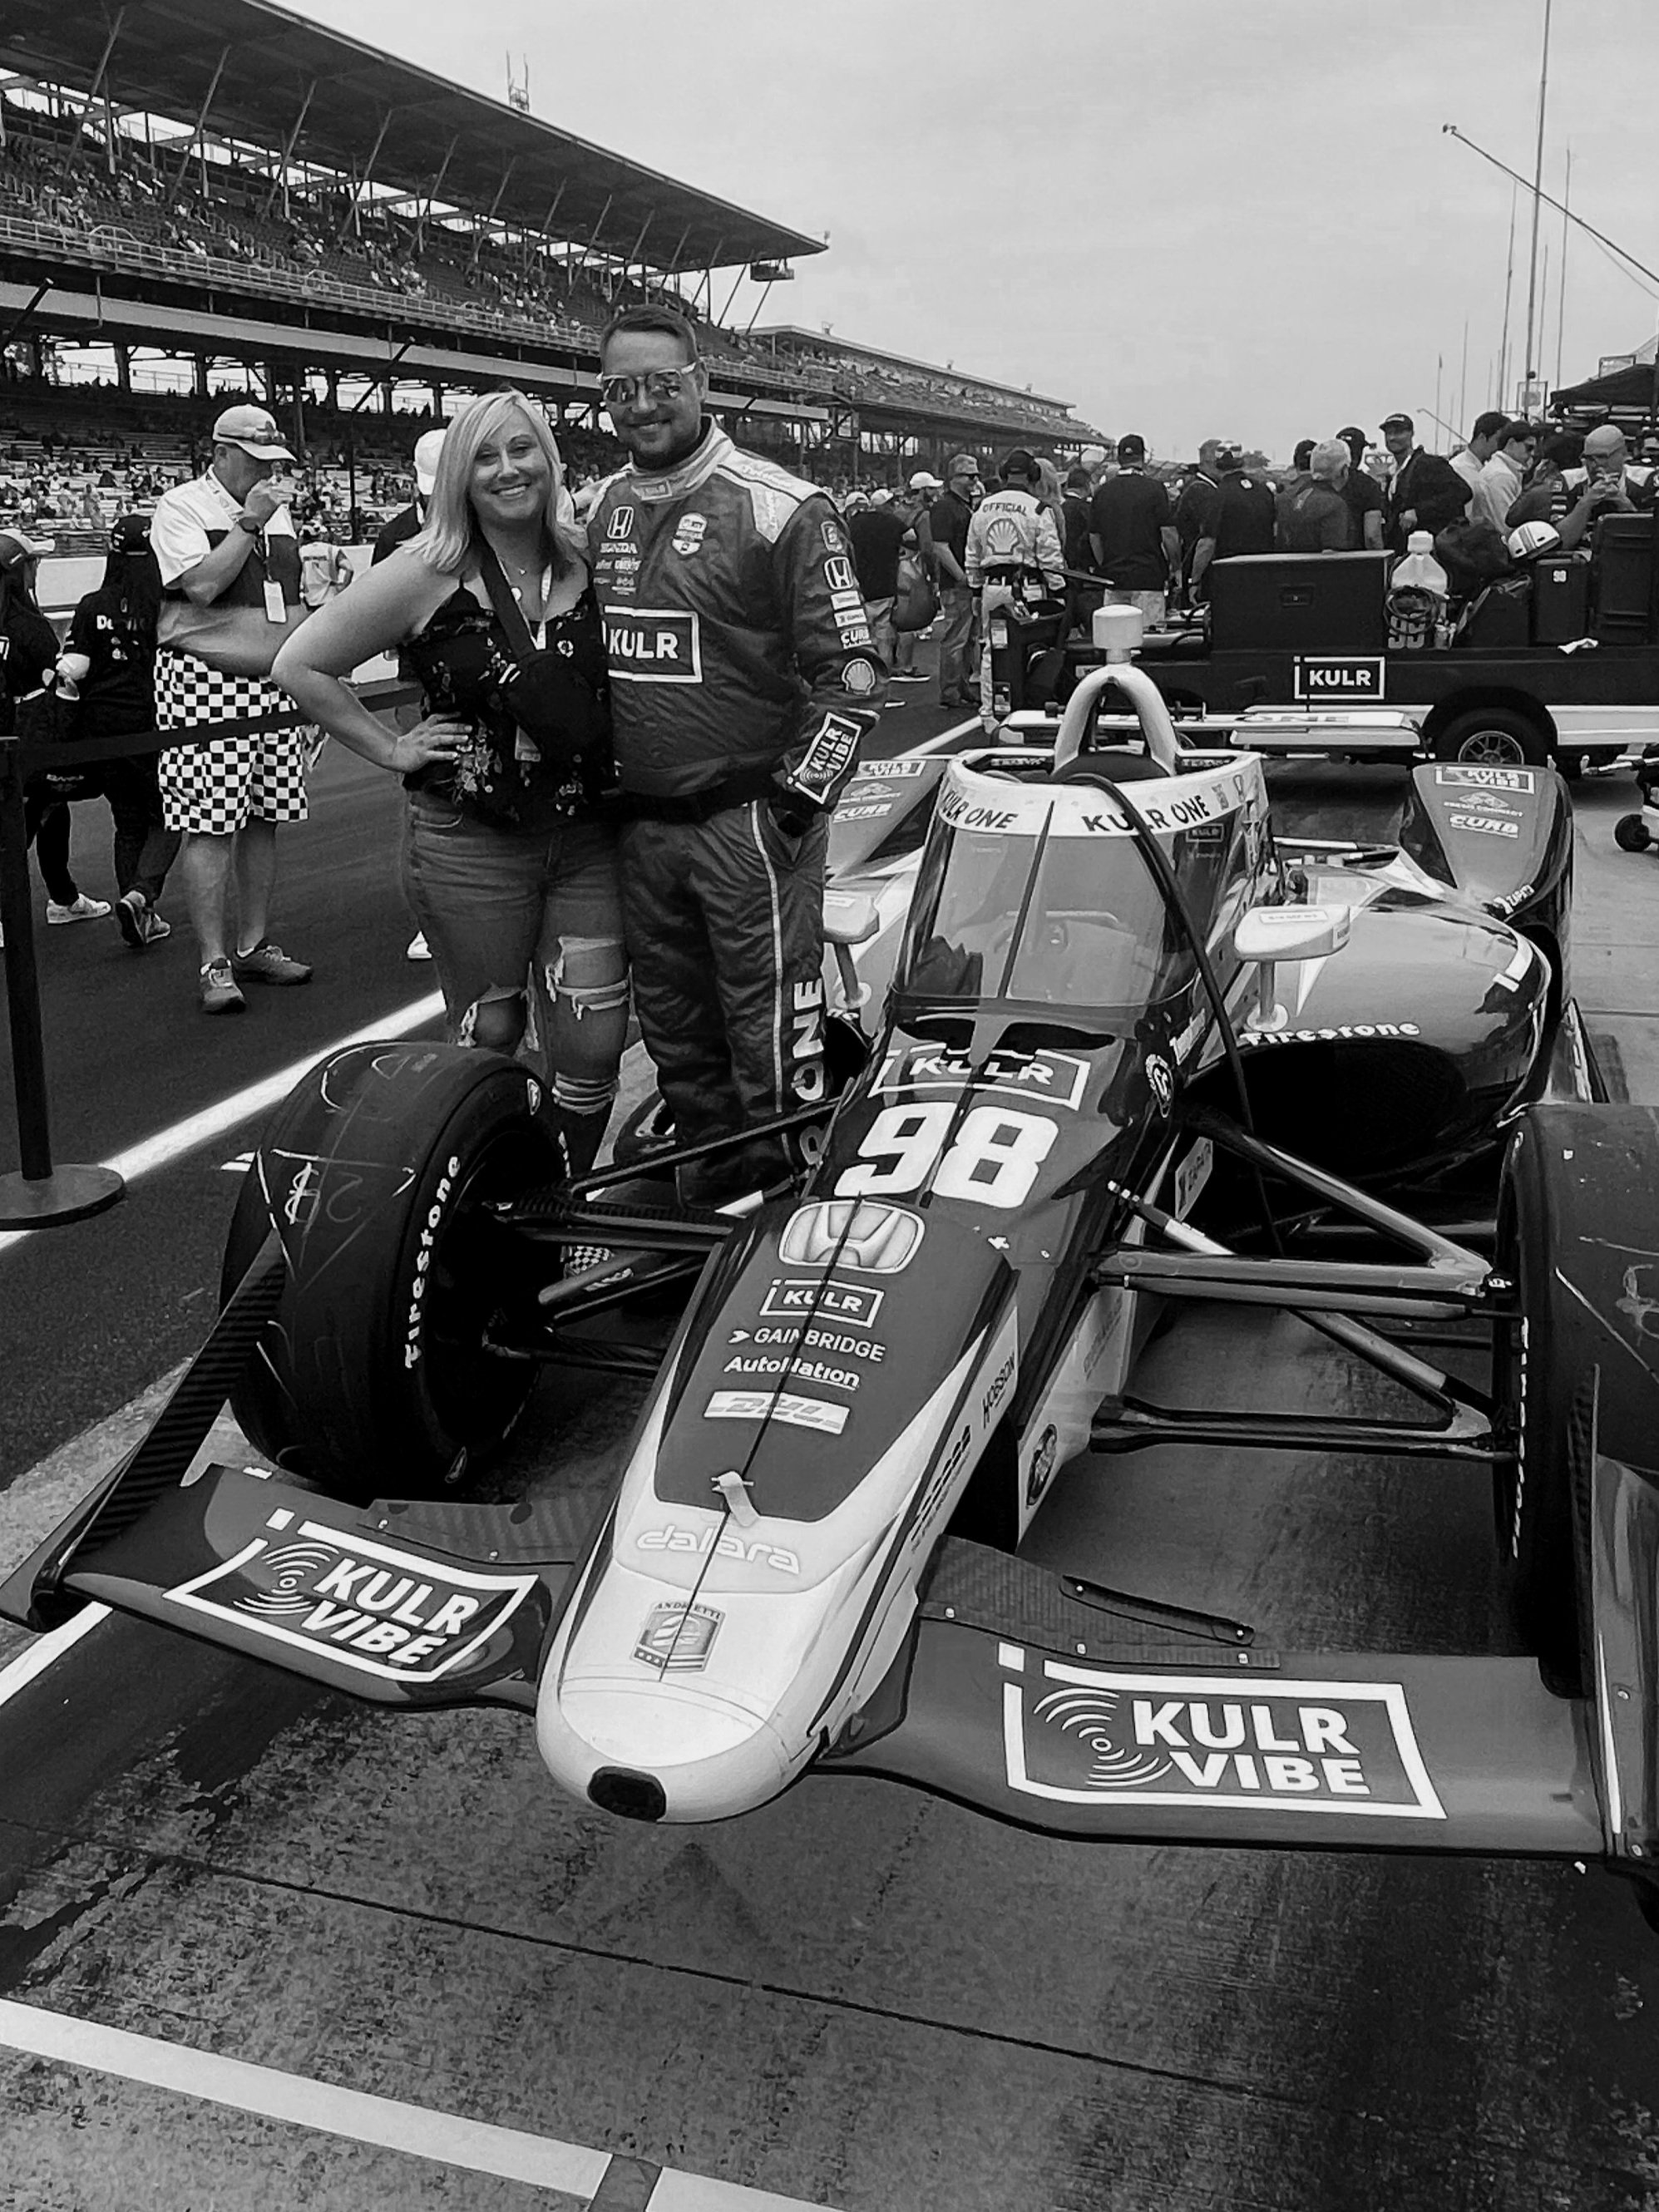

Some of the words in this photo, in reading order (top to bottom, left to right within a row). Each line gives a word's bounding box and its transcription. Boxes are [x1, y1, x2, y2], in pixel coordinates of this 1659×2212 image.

[983, 502, 1027, 516] OFFICIAL
[609, 629, 679, 659] KULR
[1309, 669, 1371, 686] KULR
[810, 726, 843, 772] KULR
[826, 733, 853, 771] VIBE
[965, 807, 1019, 828] ONE
[1171, 795, 1210, 824] ONE
[792, 978, 824, 1101] ONE
[1240, 1021, 1420, 1045] Firestone
[834, 1099, 1059, 1208] 98
[405, 1156, 461, 1369] Firestone
[783, 1290, 863, 1312] KULR
[753, 1327, 886, 1363] GAINBRIDGE
[723, 1356, 861, 1390] AutoNation
[313, 1558, 480, 1635] KULR
[300, 1599, 448, 1665] VIBE
[1133, 1699, 1361, 1755] KULR
[1168, 1751, 1371, 1795] VIBE
